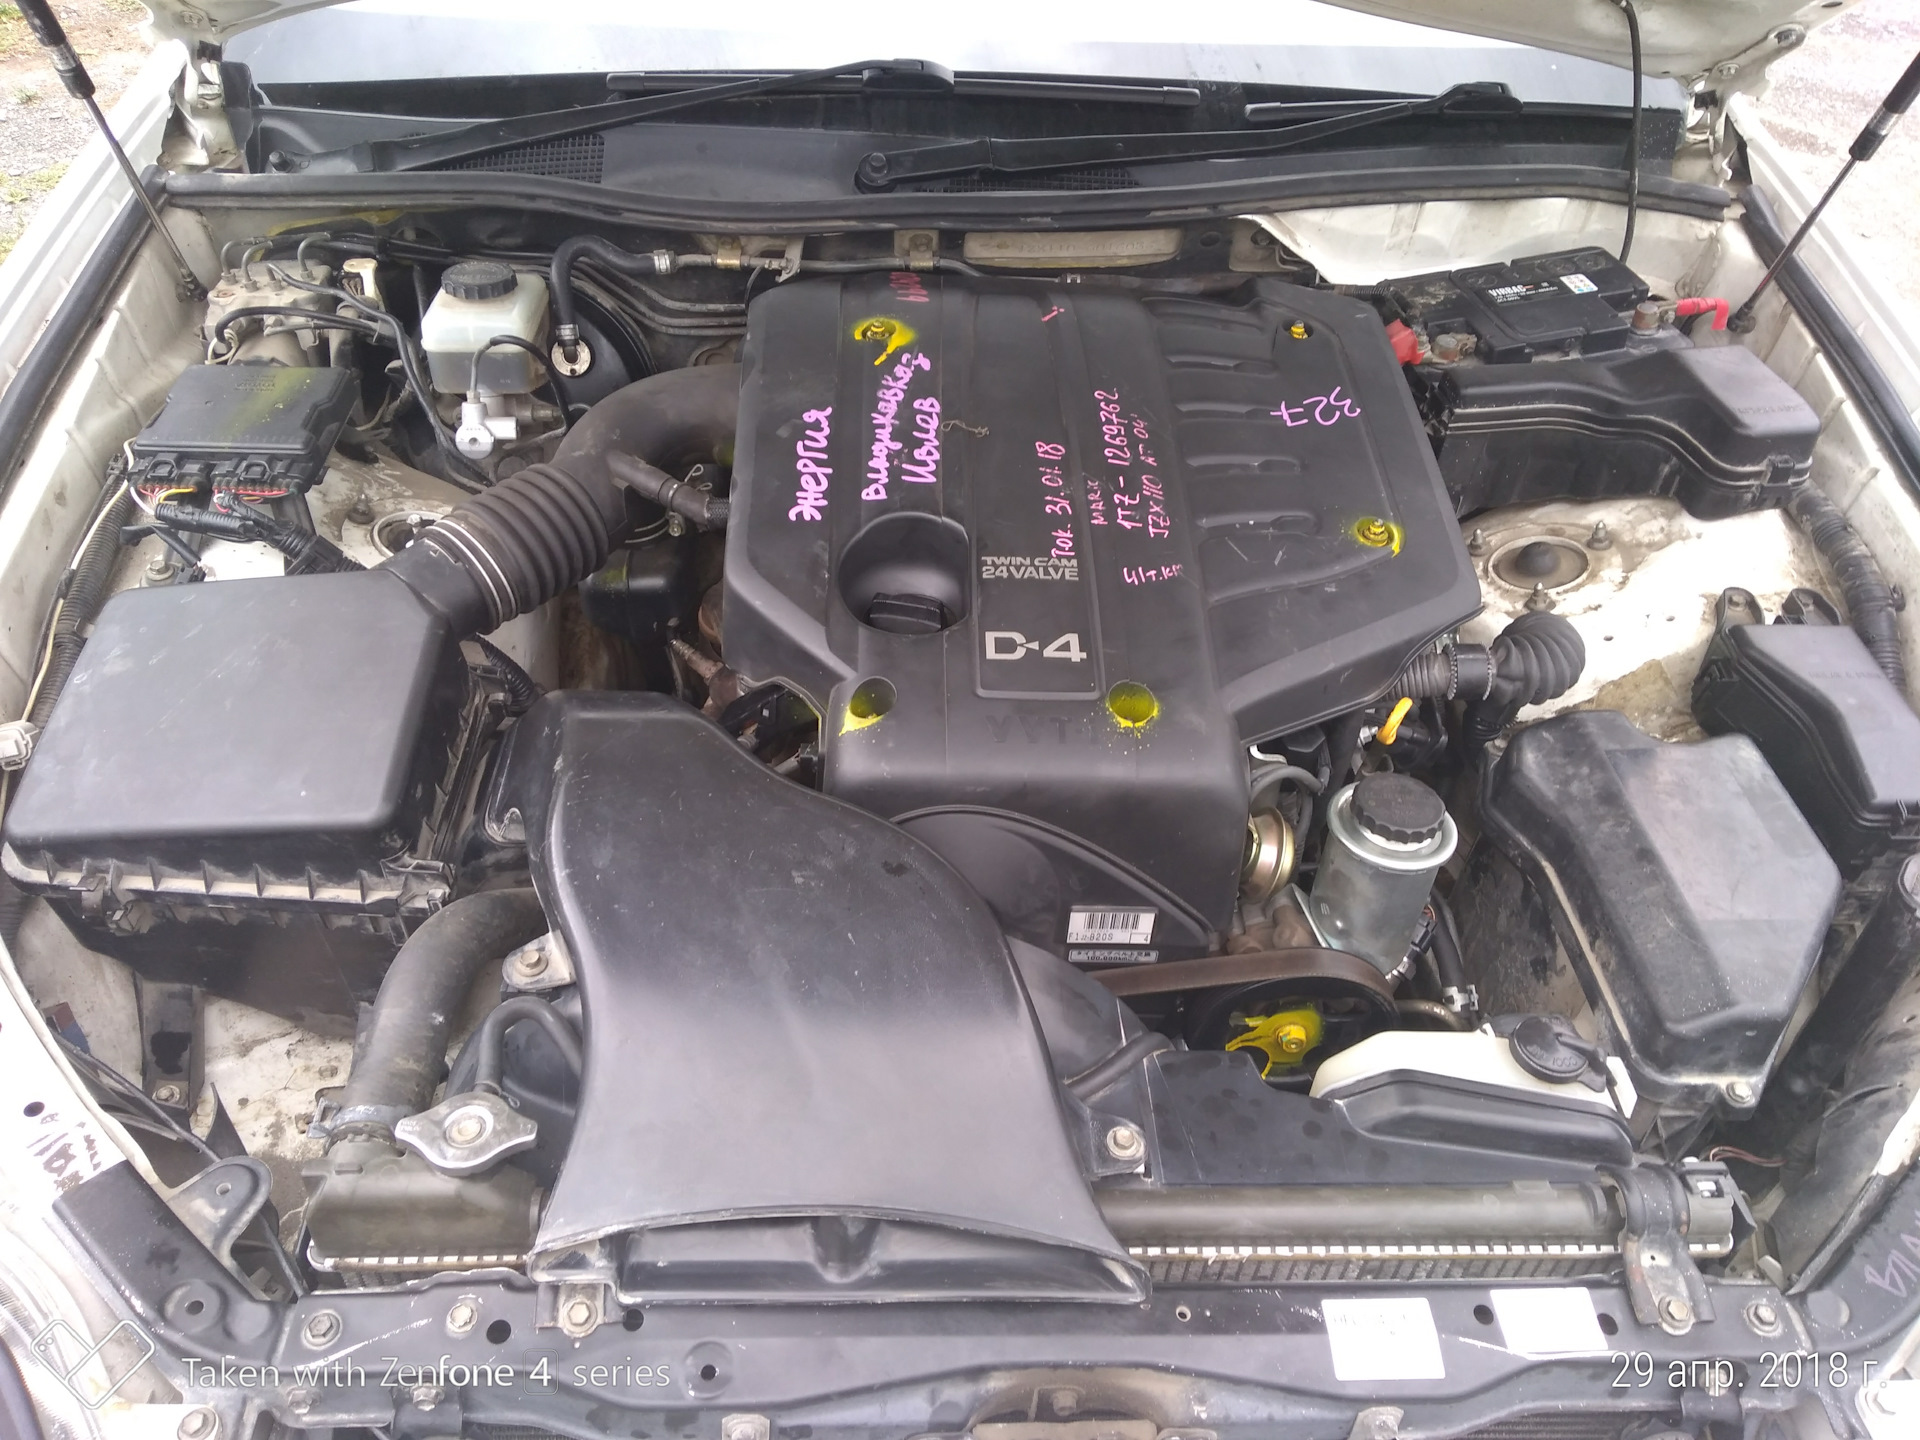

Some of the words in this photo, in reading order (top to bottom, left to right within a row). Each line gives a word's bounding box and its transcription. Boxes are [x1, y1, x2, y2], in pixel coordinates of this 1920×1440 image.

[1488, 284, 1527, 297] VIRBAC
[1270, 386, 1361, 427] 327
[982, 556, 1031, 566] TWIN
[1034, 557, 1078, 568] CAM
